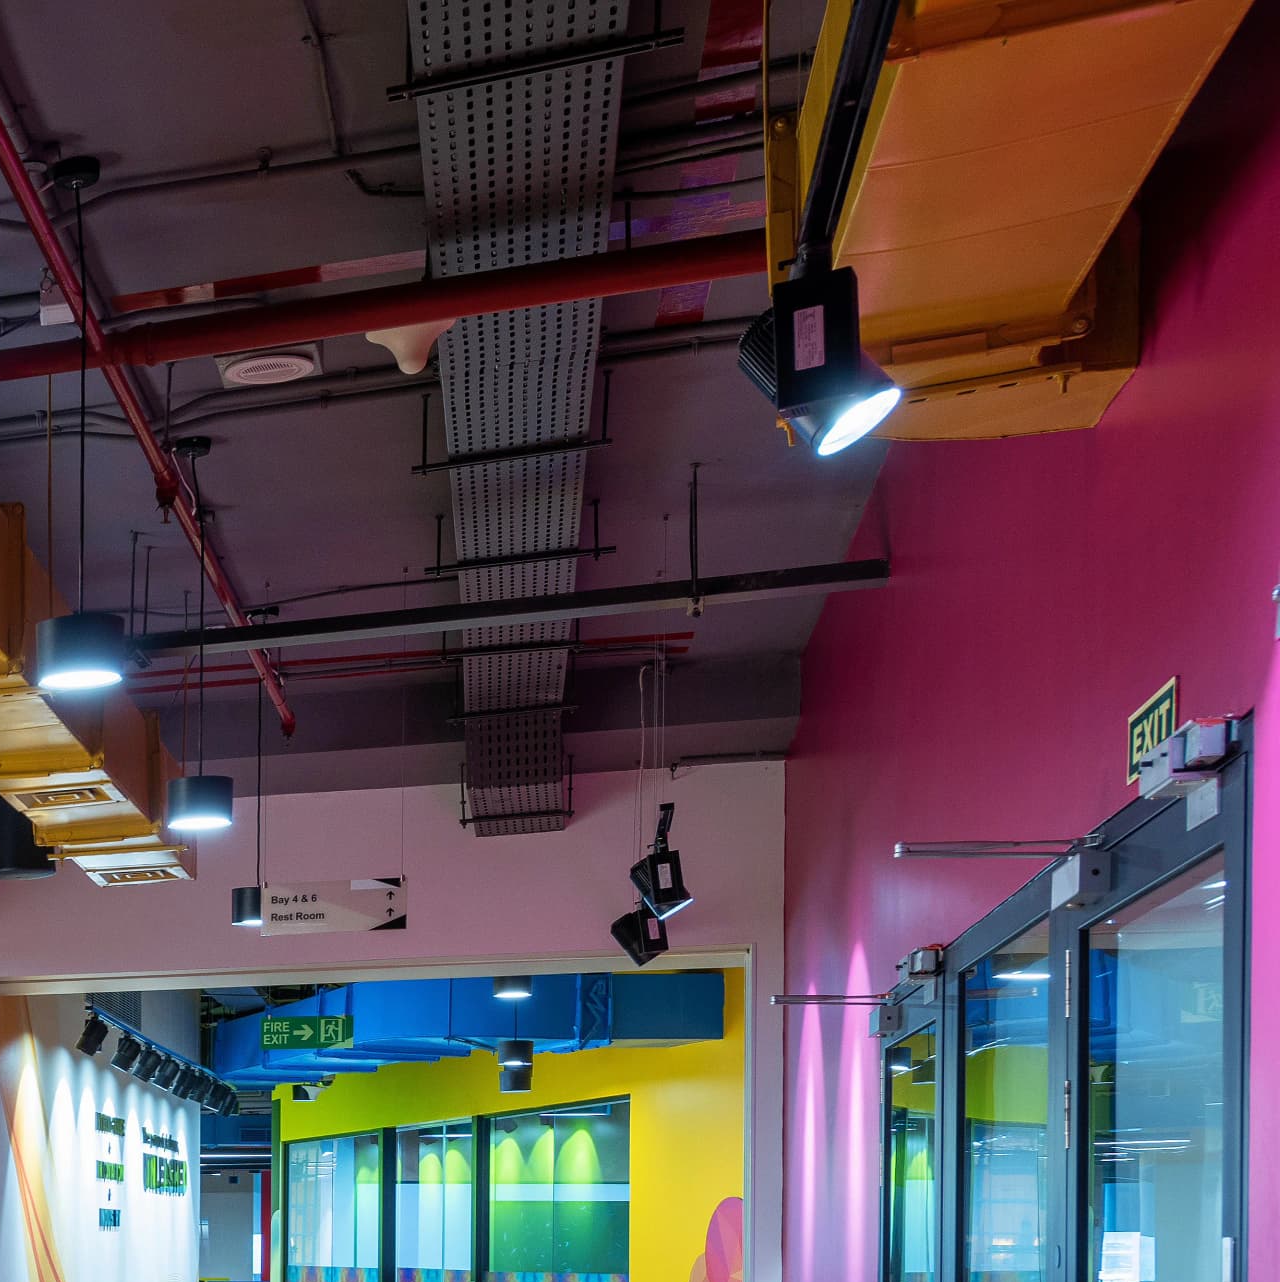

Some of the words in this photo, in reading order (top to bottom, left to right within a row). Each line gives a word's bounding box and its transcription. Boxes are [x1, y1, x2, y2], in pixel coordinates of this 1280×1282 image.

[1132, 698, 1171, 765] EXIT
[271, 895, 290, 906] Bay
[292, 895, 298, 903] 4
[301, 894, 309, 903] &
[311, 894, 318, 903] 6
[271, 912, 293, 922] Rest
[296, 911, 325, 921] Room
[263, 1022, 290, 1033] FIRE
[263, 1034, 289, 1045] EXIT
